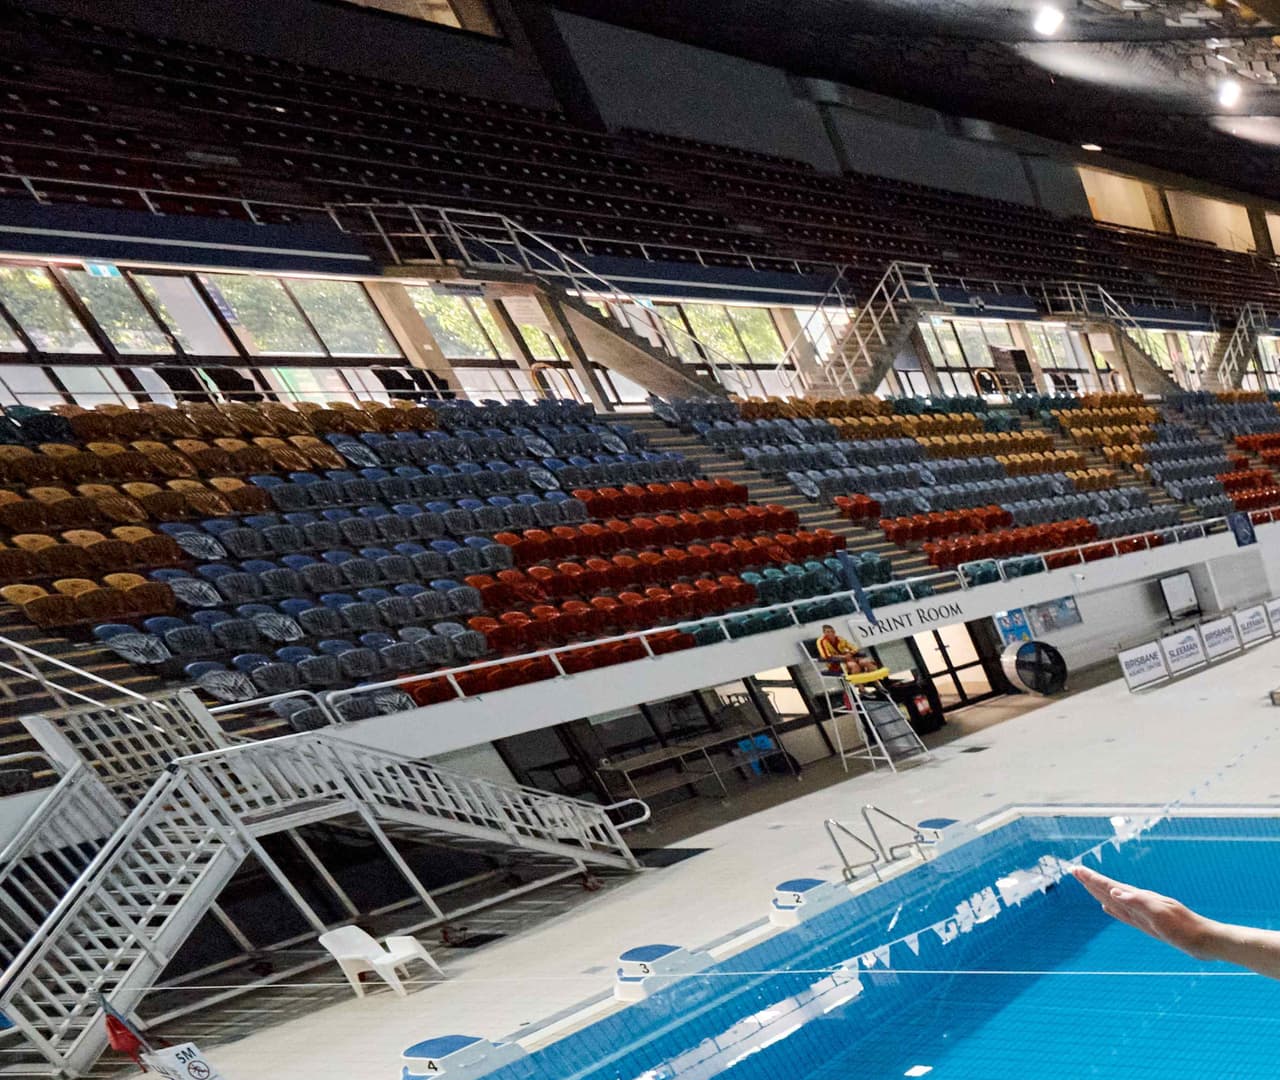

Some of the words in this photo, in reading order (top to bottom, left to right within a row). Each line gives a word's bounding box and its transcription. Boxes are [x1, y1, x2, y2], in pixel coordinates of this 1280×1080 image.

[915, 601, 964, 623] ROOM
[933, 831, 940, 839] 1
[792, 893, 802, 904] 2
[639, 963, 650, 974] 3
[175, 1046, 197, 1065] 5M
[427, 1060, 438, 1071] 4
